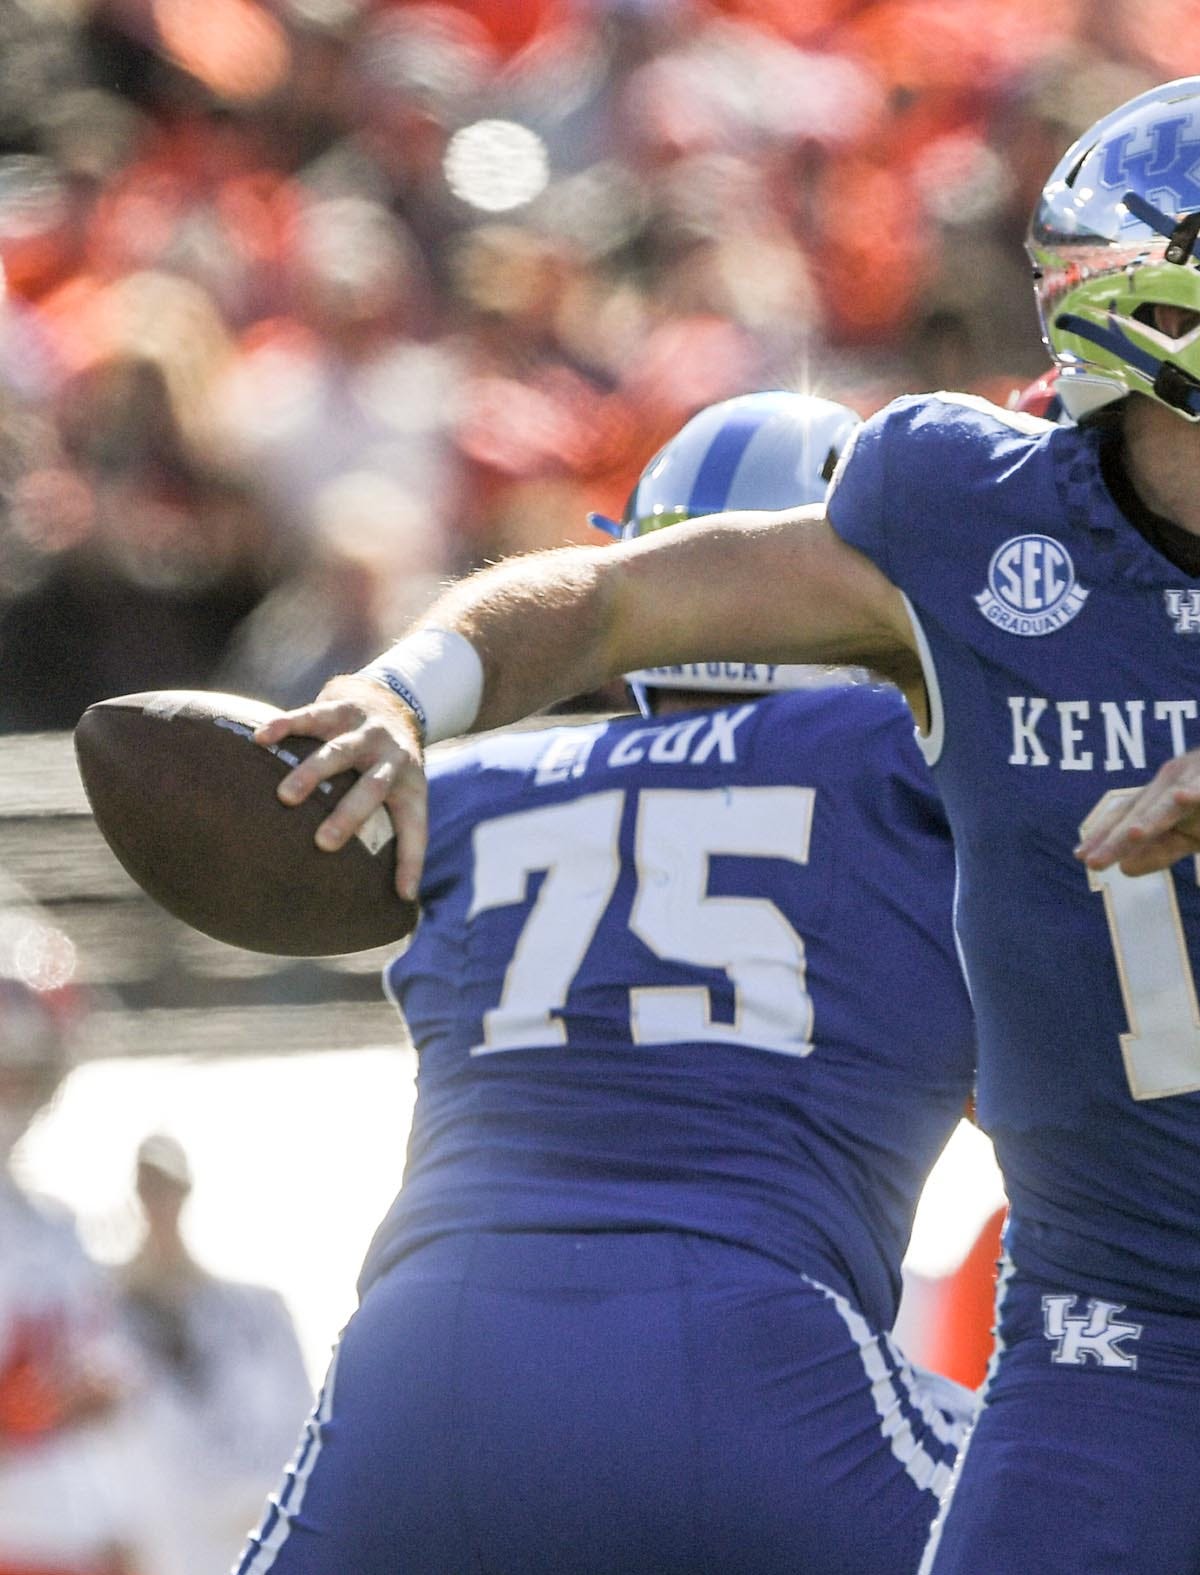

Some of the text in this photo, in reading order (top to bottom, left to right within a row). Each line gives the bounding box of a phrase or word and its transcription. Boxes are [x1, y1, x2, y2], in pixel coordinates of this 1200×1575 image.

[997, 540, 1065, 609] SEC
[986, 601, 1075, 633] GRADUATE
[607, 704, 758, 767] COX
[466, 786, 816, 1057] 75
[1041, 1294, 1143, 1370] UK
